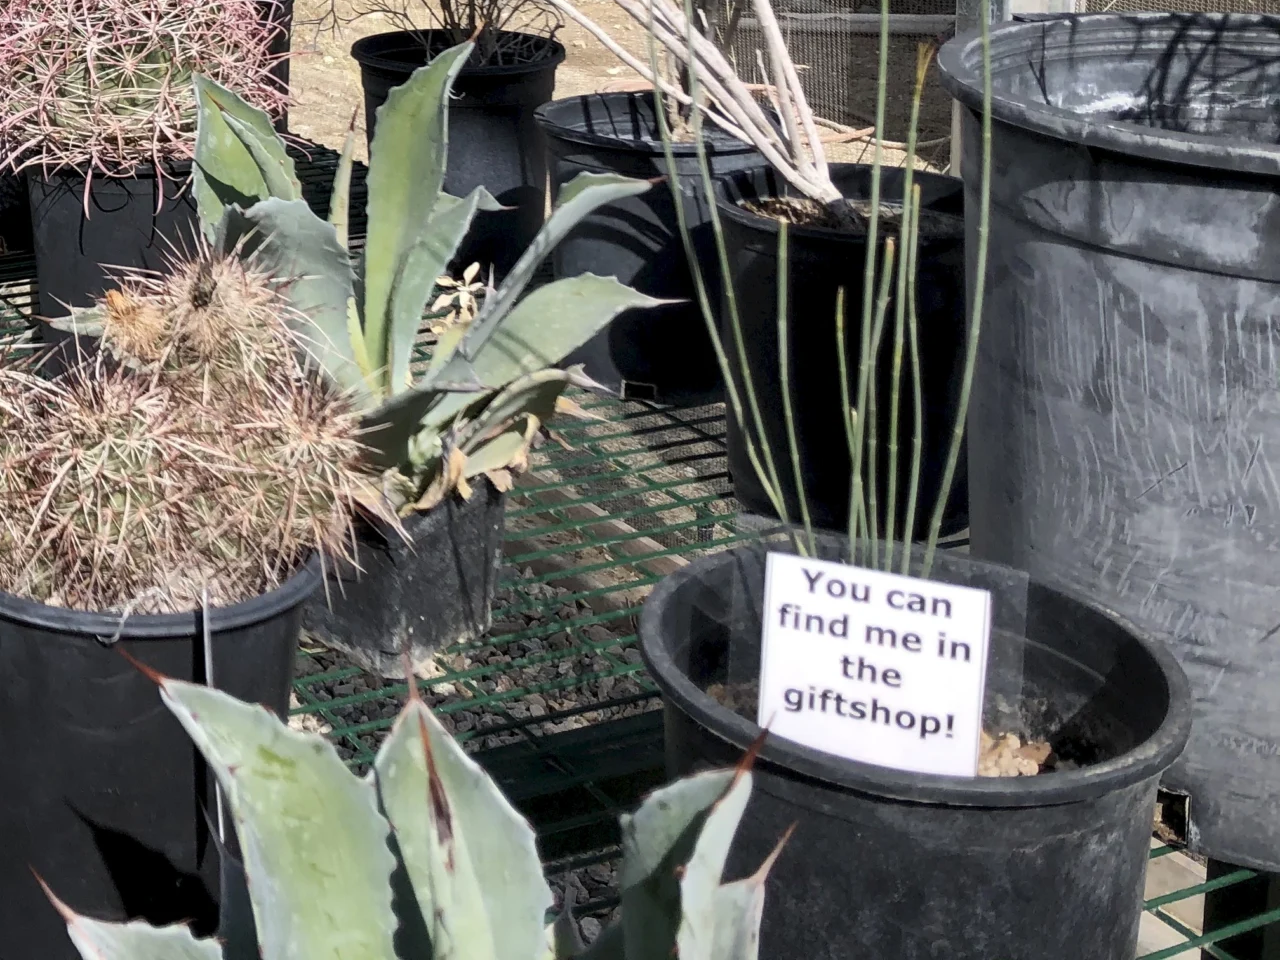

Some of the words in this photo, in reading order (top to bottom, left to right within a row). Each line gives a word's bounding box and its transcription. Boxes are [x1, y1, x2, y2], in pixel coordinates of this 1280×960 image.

[801, 567, 871, 603] You
[886, 588, 952, 618] can
[778, 603, 849, 639] find
[865, 625, 922, 653] me
[937, 632, 971, 662] in
[840, 655, 902, 688] the
[783, 686, 955, 739] giftshop!
